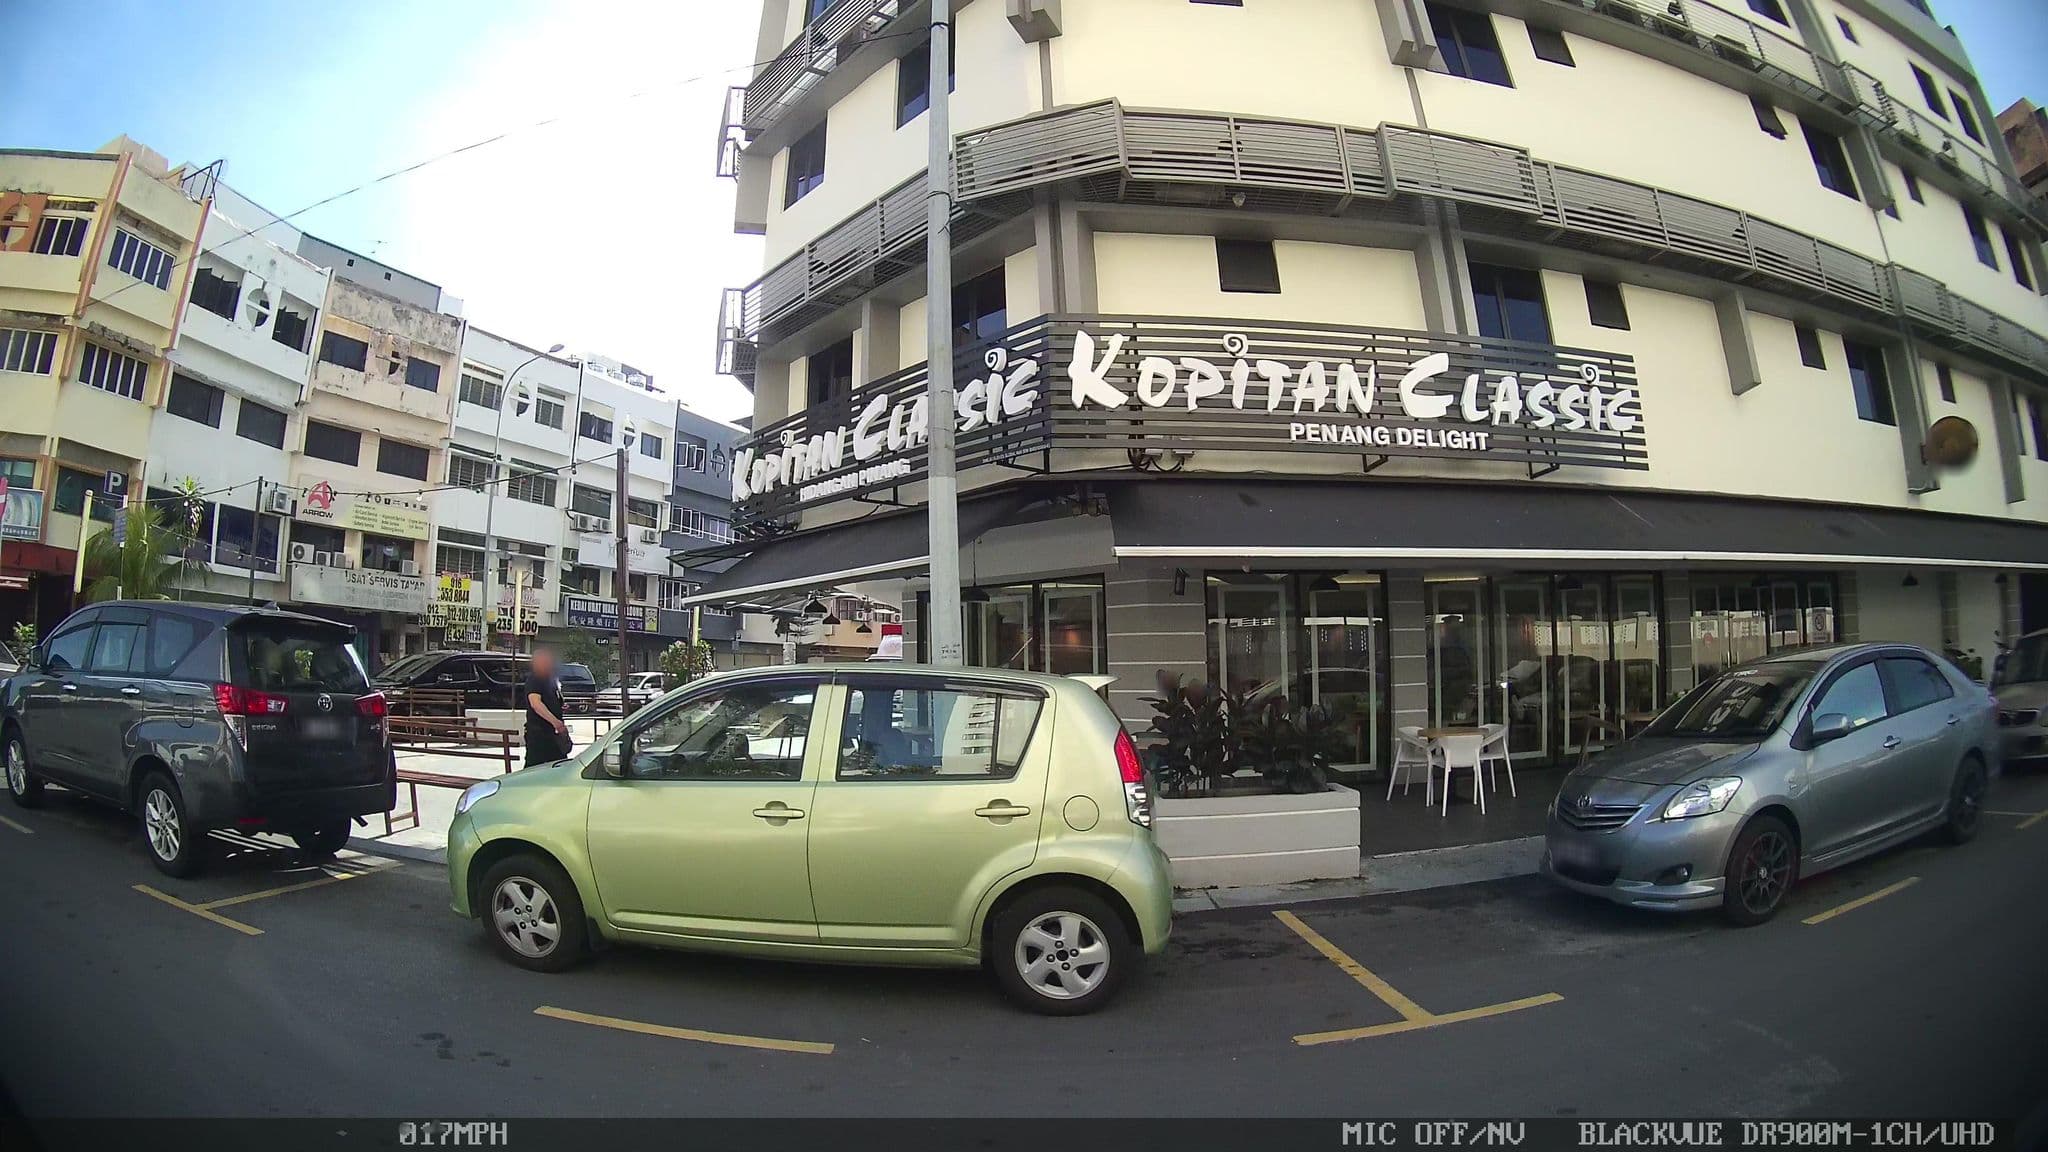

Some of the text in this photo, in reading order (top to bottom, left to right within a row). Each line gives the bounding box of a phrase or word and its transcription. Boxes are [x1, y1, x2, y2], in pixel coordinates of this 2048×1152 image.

[1290, 422, 1490, 452] PENANG DELIGHT
[859, 458, 911, 486] PINANG
[109, 472, 122, 492] P
[302, 508, 333, 519] ARROW
[427, 604, 440, 614] 012
[496, 617, 512, 631] 235
